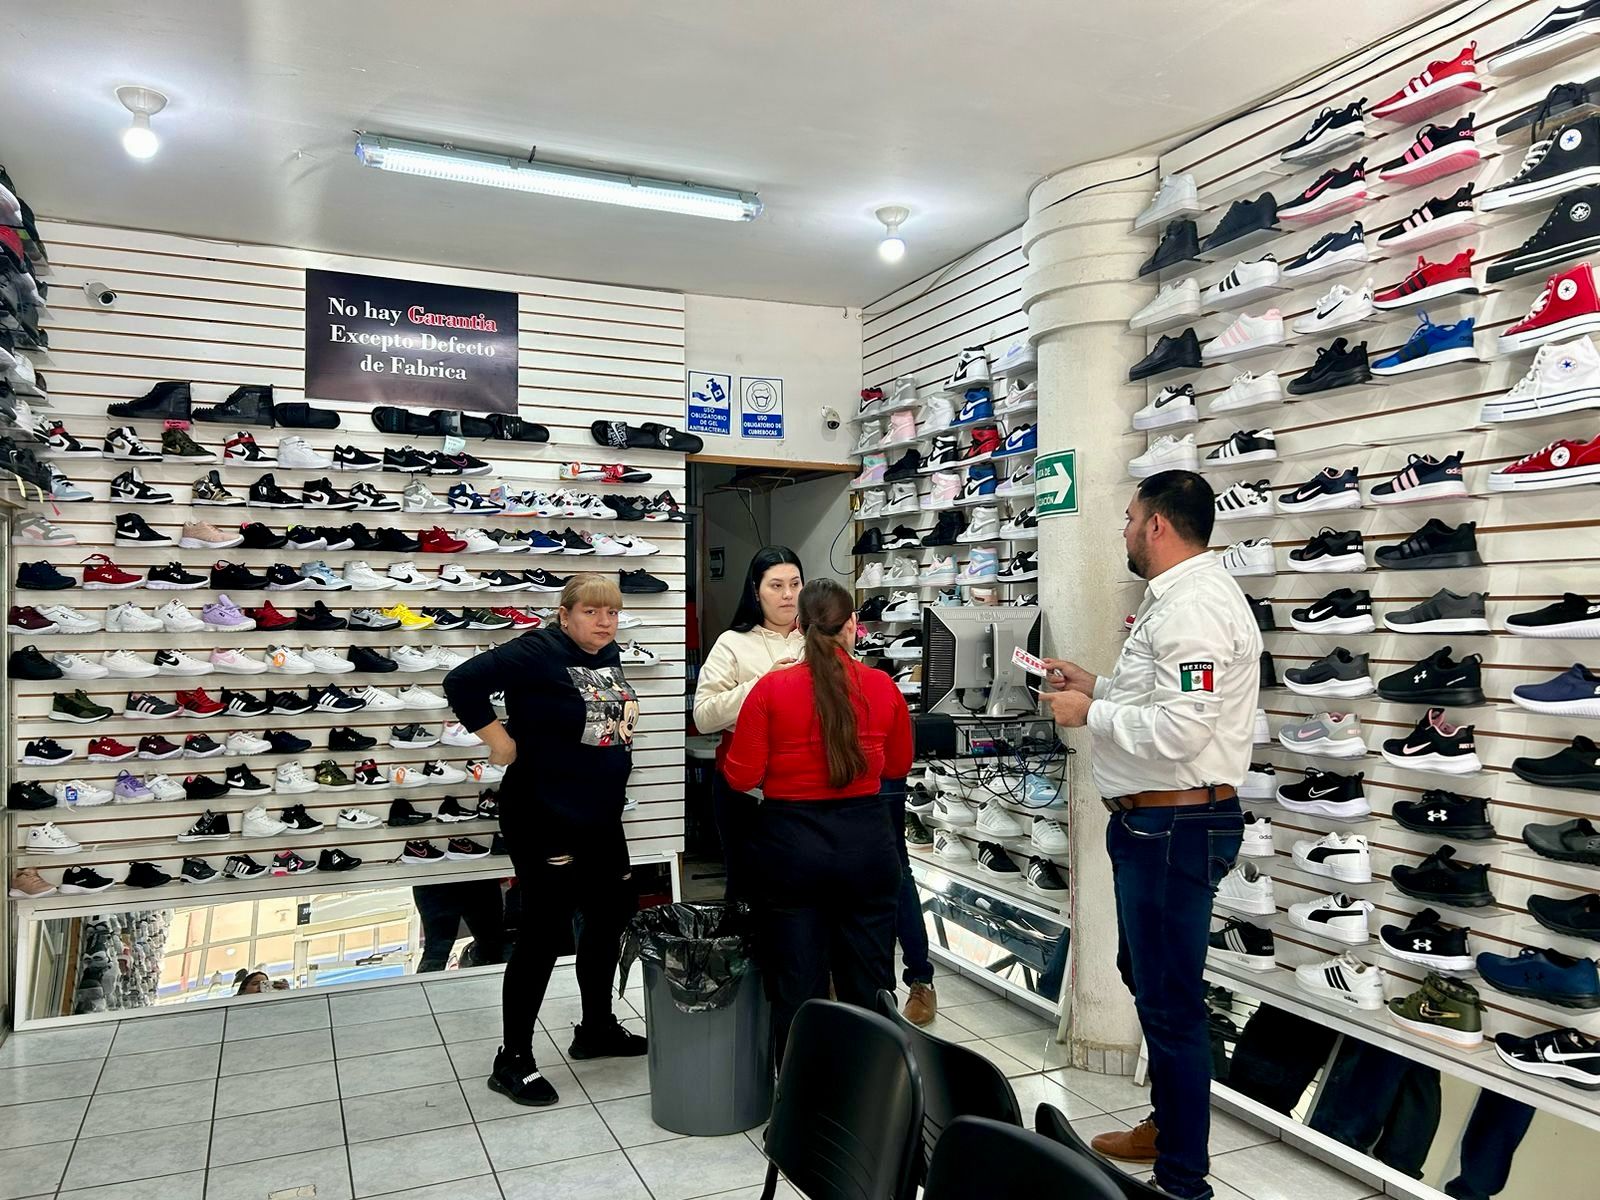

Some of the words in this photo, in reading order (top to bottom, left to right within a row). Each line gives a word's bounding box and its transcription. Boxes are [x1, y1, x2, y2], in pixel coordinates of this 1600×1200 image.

[328, 297, 358, 317] No
[364, 301, 402, 327] hay
[407, 305, 497, 332] Garantia
[329, 324, 414, 352] Excepto
[420, 333, 495, 357] Defecto
[360, 355, 384, 373] de
[390, 357, 467, 380] Fabrica
[689, 425, 728, 433] ANTIBACTERIAL
[690, 412, 727, 421] OBLIGATORIO
